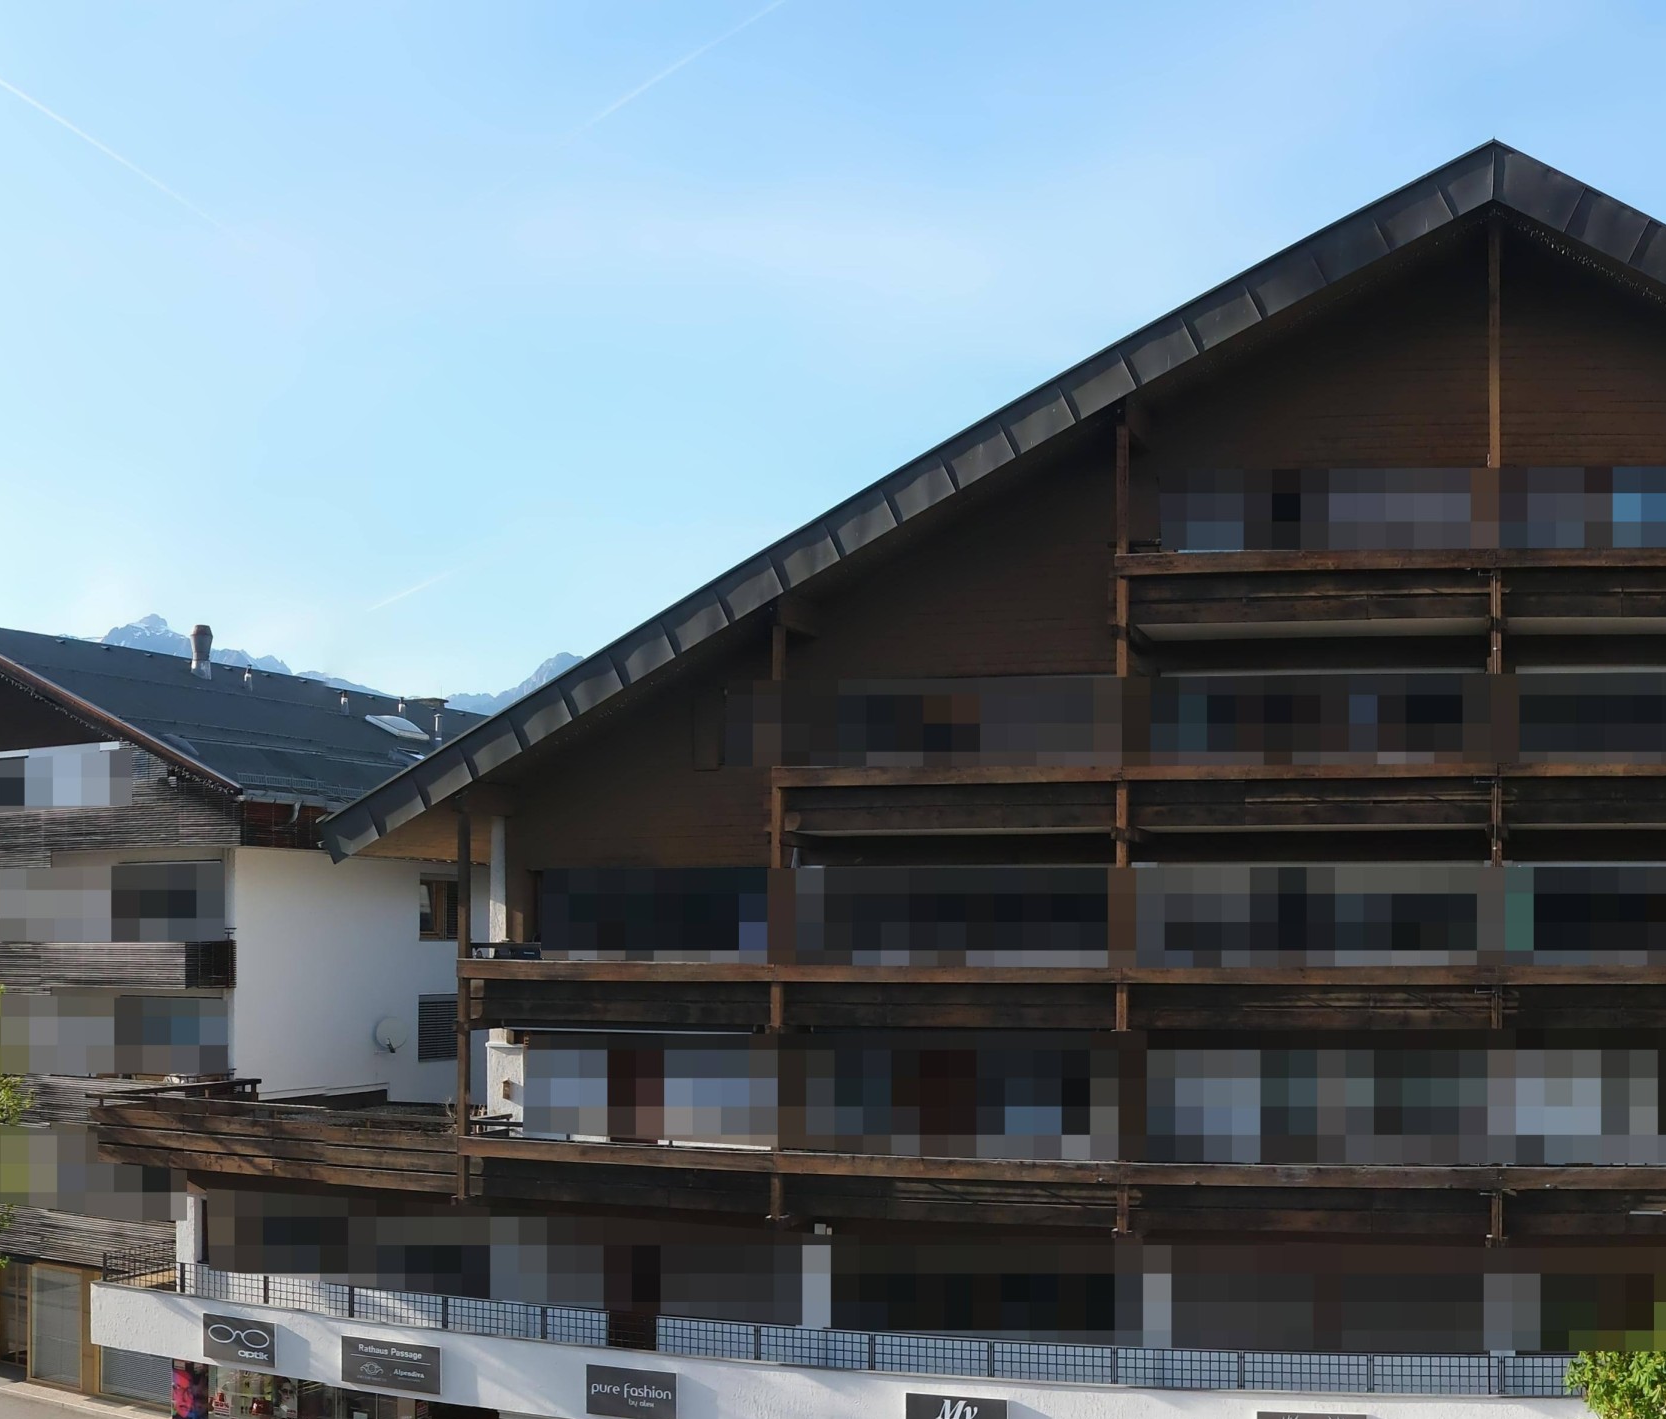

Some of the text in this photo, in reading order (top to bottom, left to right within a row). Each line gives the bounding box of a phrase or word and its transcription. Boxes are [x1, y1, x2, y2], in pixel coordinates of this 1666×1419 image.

[237, 1350, 269, 1361] optik
[358, 1343, 423, 1360] Rathaus Passage
[591, 1382, 672, 1399] pure fashion
[628, 1399, 638, 1407] by
